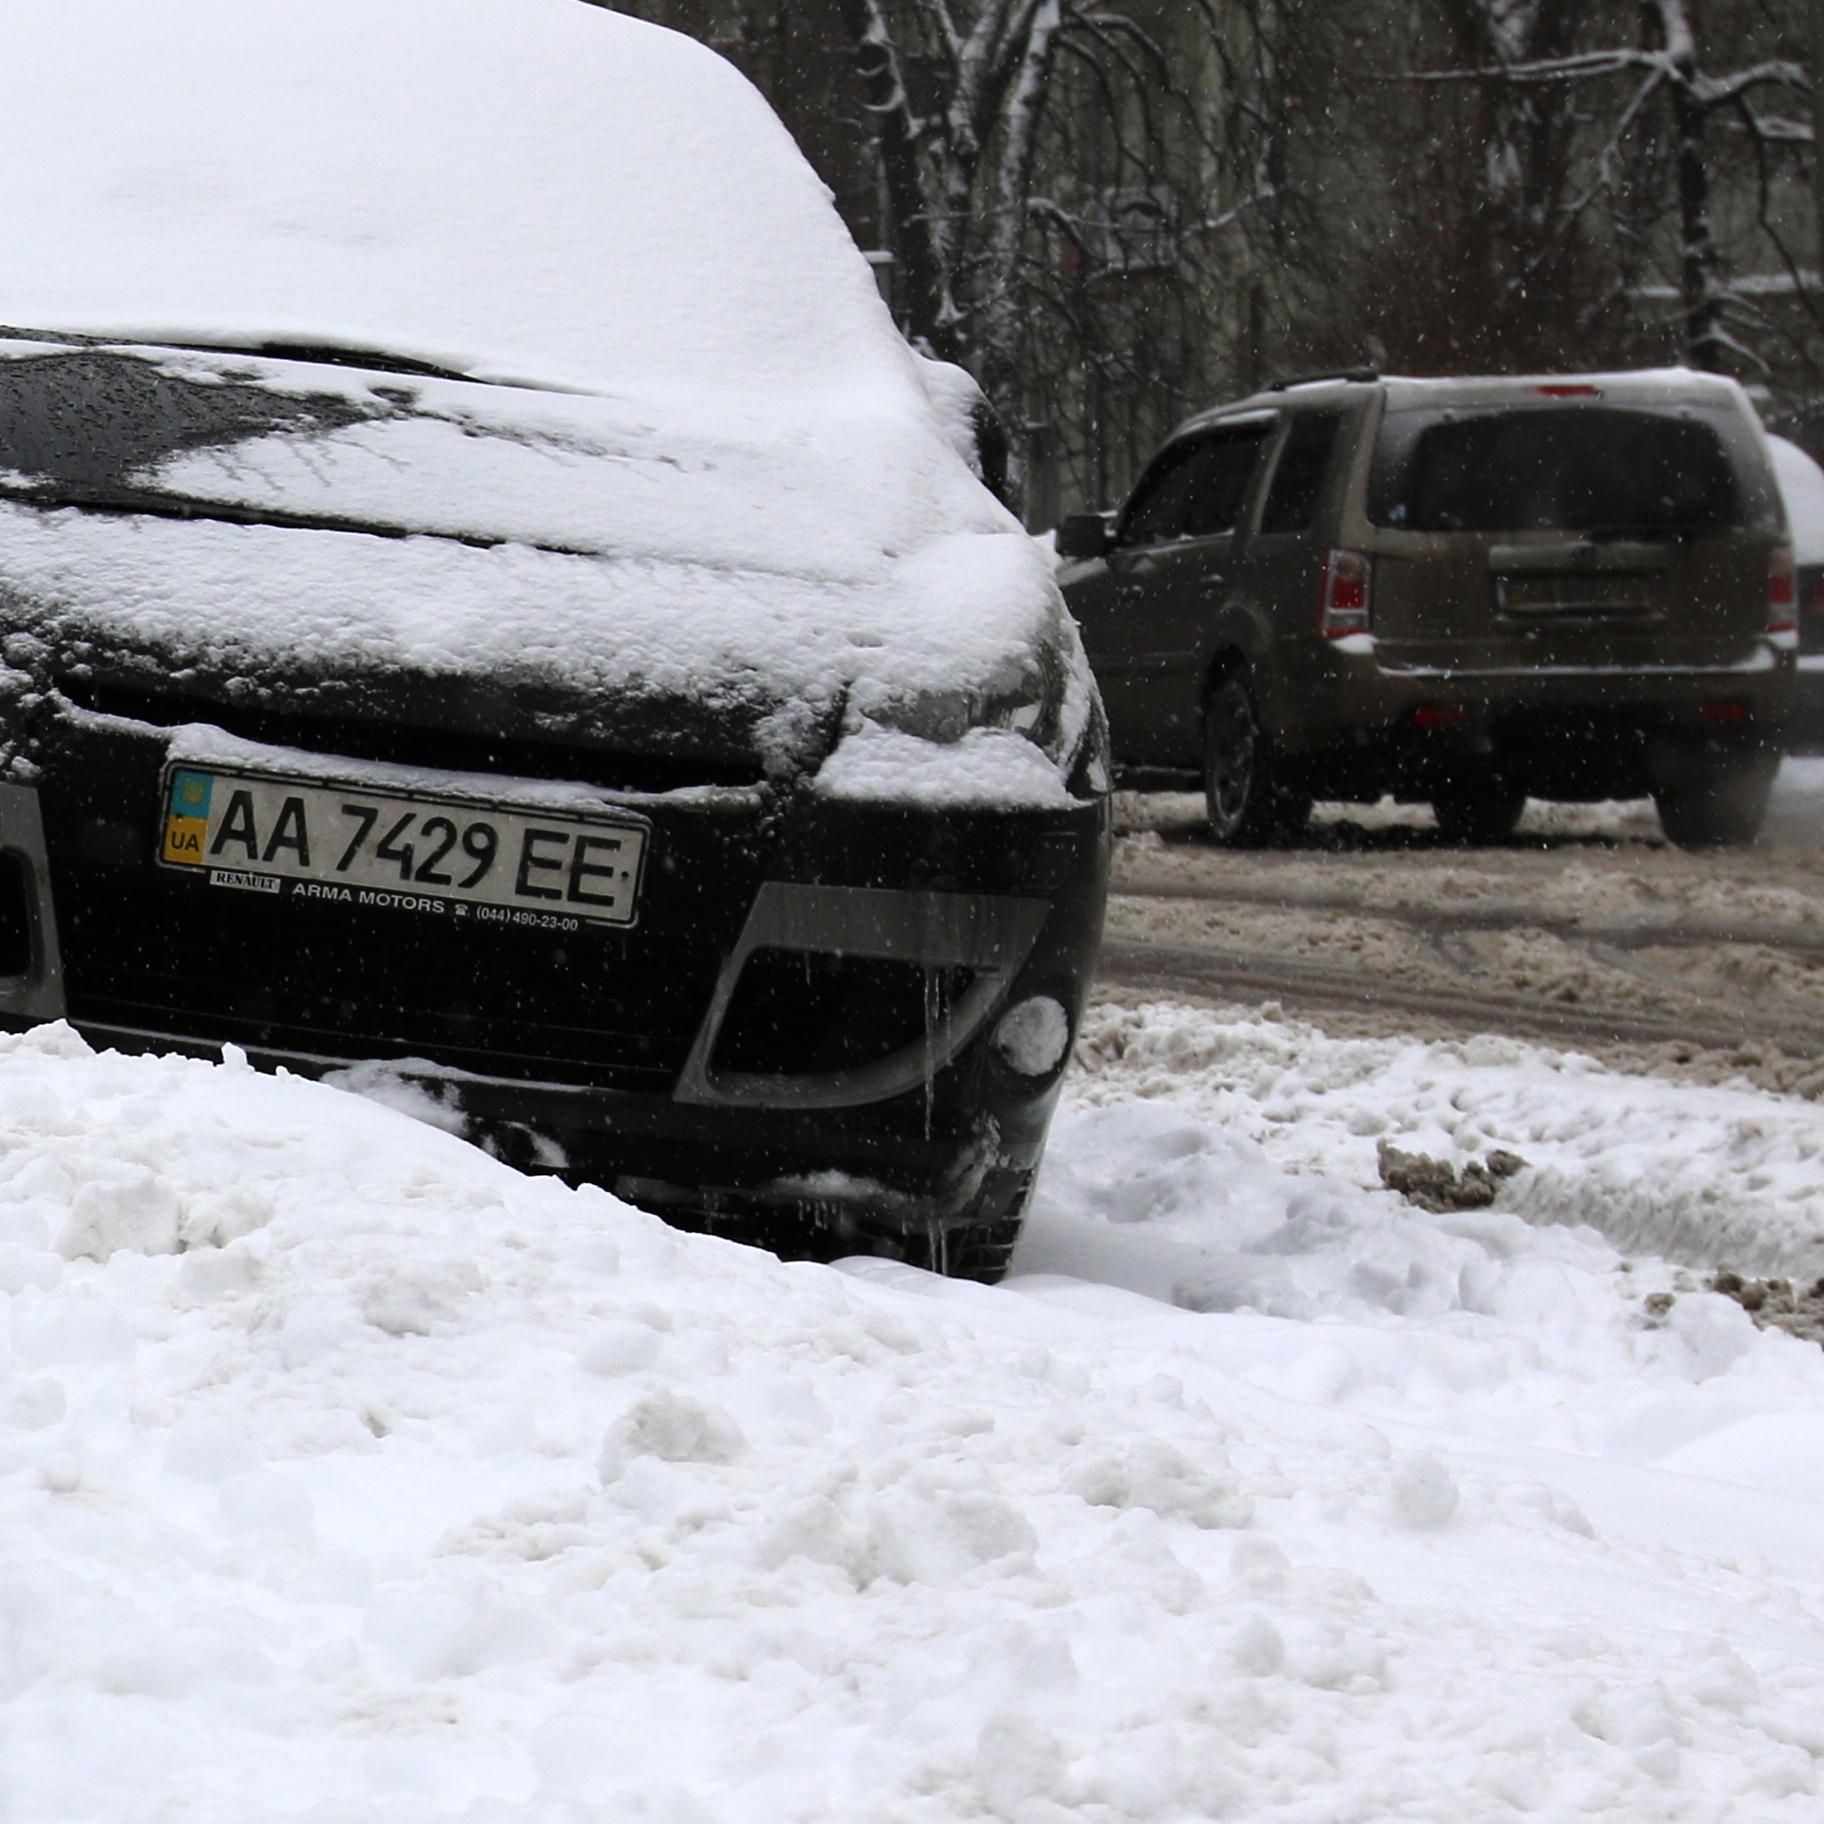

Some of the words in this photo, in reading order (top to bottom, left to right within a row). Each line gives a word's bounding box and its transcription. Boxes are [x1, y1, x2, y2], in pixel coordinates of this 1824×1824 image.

[170, 829, 201, 854] UA
[210, 789, 311, 868] AA
[335, 804, 500, 889] 7429
[514, 827, 622, 907] EE
[215, 871, 277, 892] RENAULT
[292, 882, 353, 903] ARMA
[358, 890, 446, 914] MOTORS
[512, 911, 579, 932] 490-23-00
